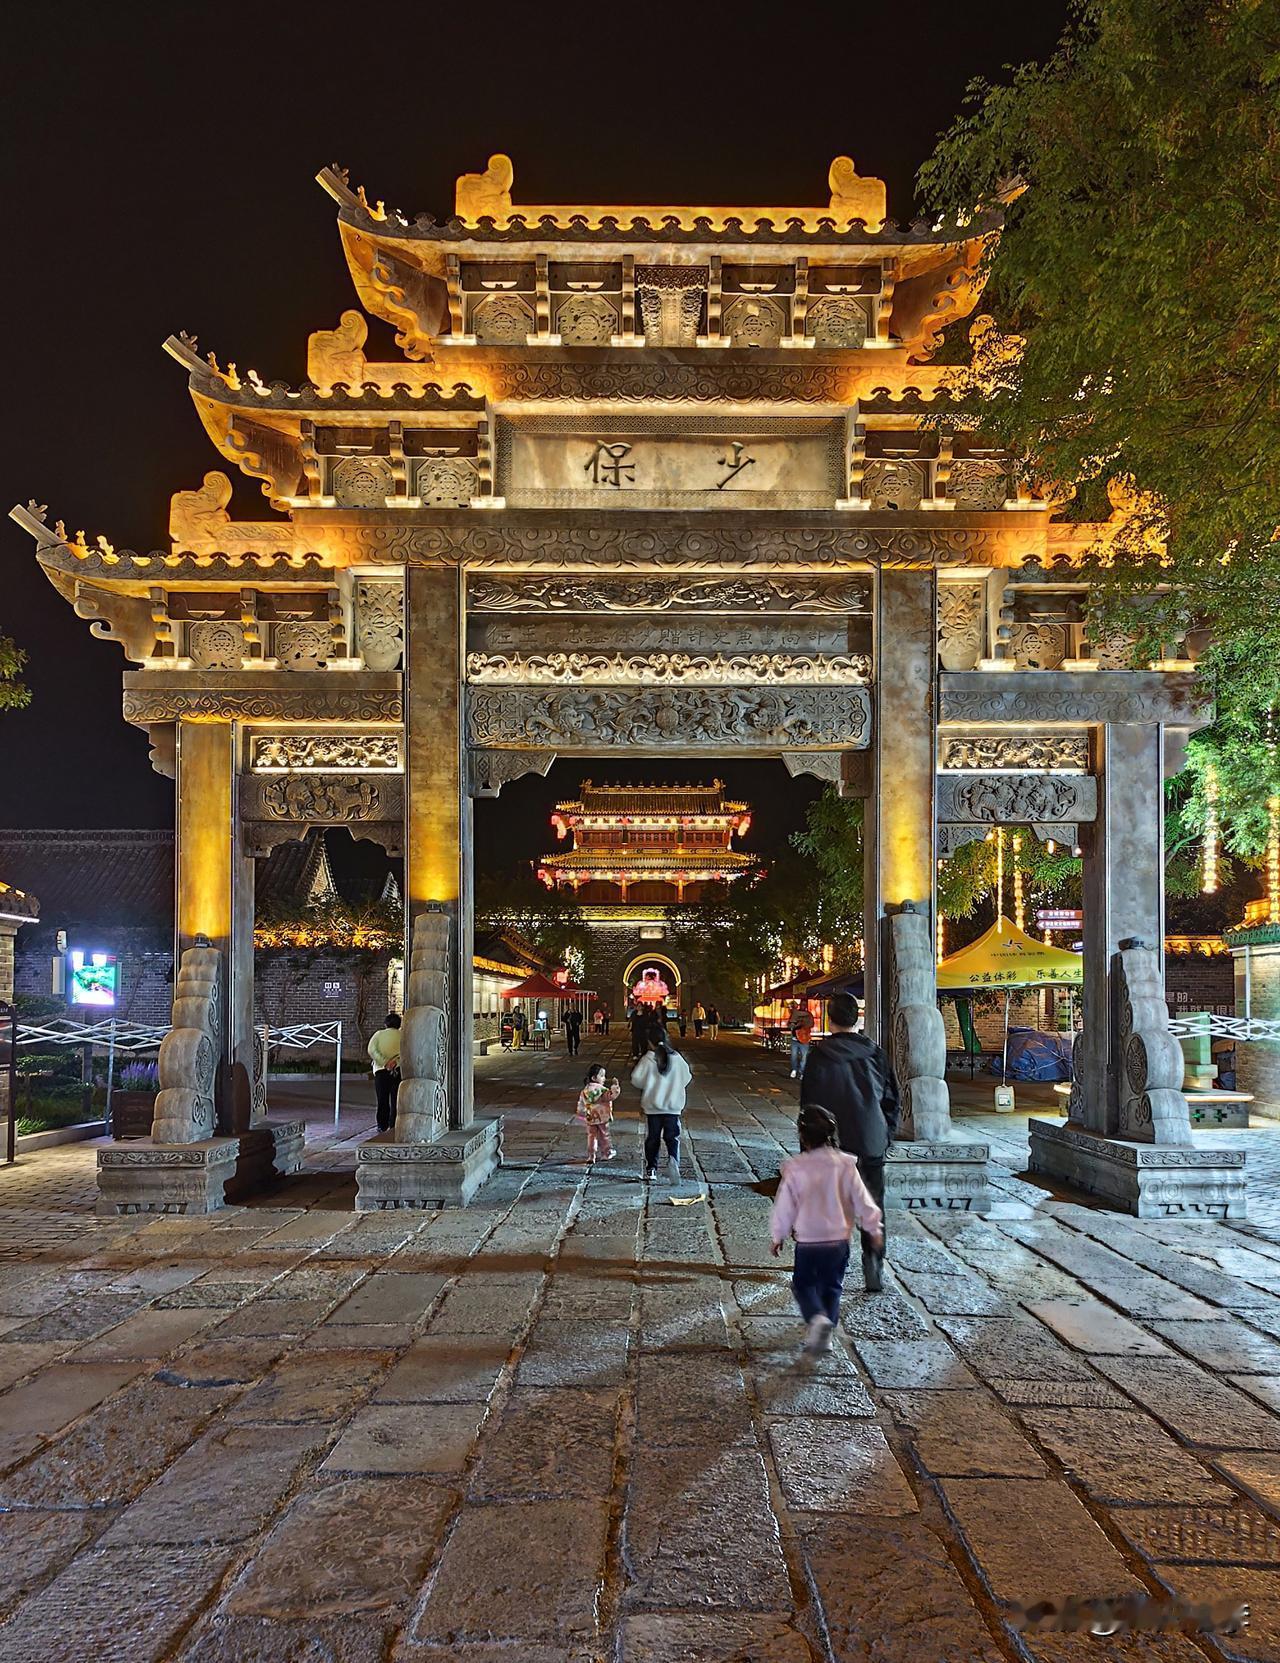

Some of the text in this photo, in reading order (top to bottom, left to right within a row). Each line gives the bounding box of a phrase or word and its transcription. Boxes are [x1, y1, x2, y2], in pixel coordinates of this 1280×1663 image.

[969, 968, 1082, 983] 公益体彩 乐善人生
